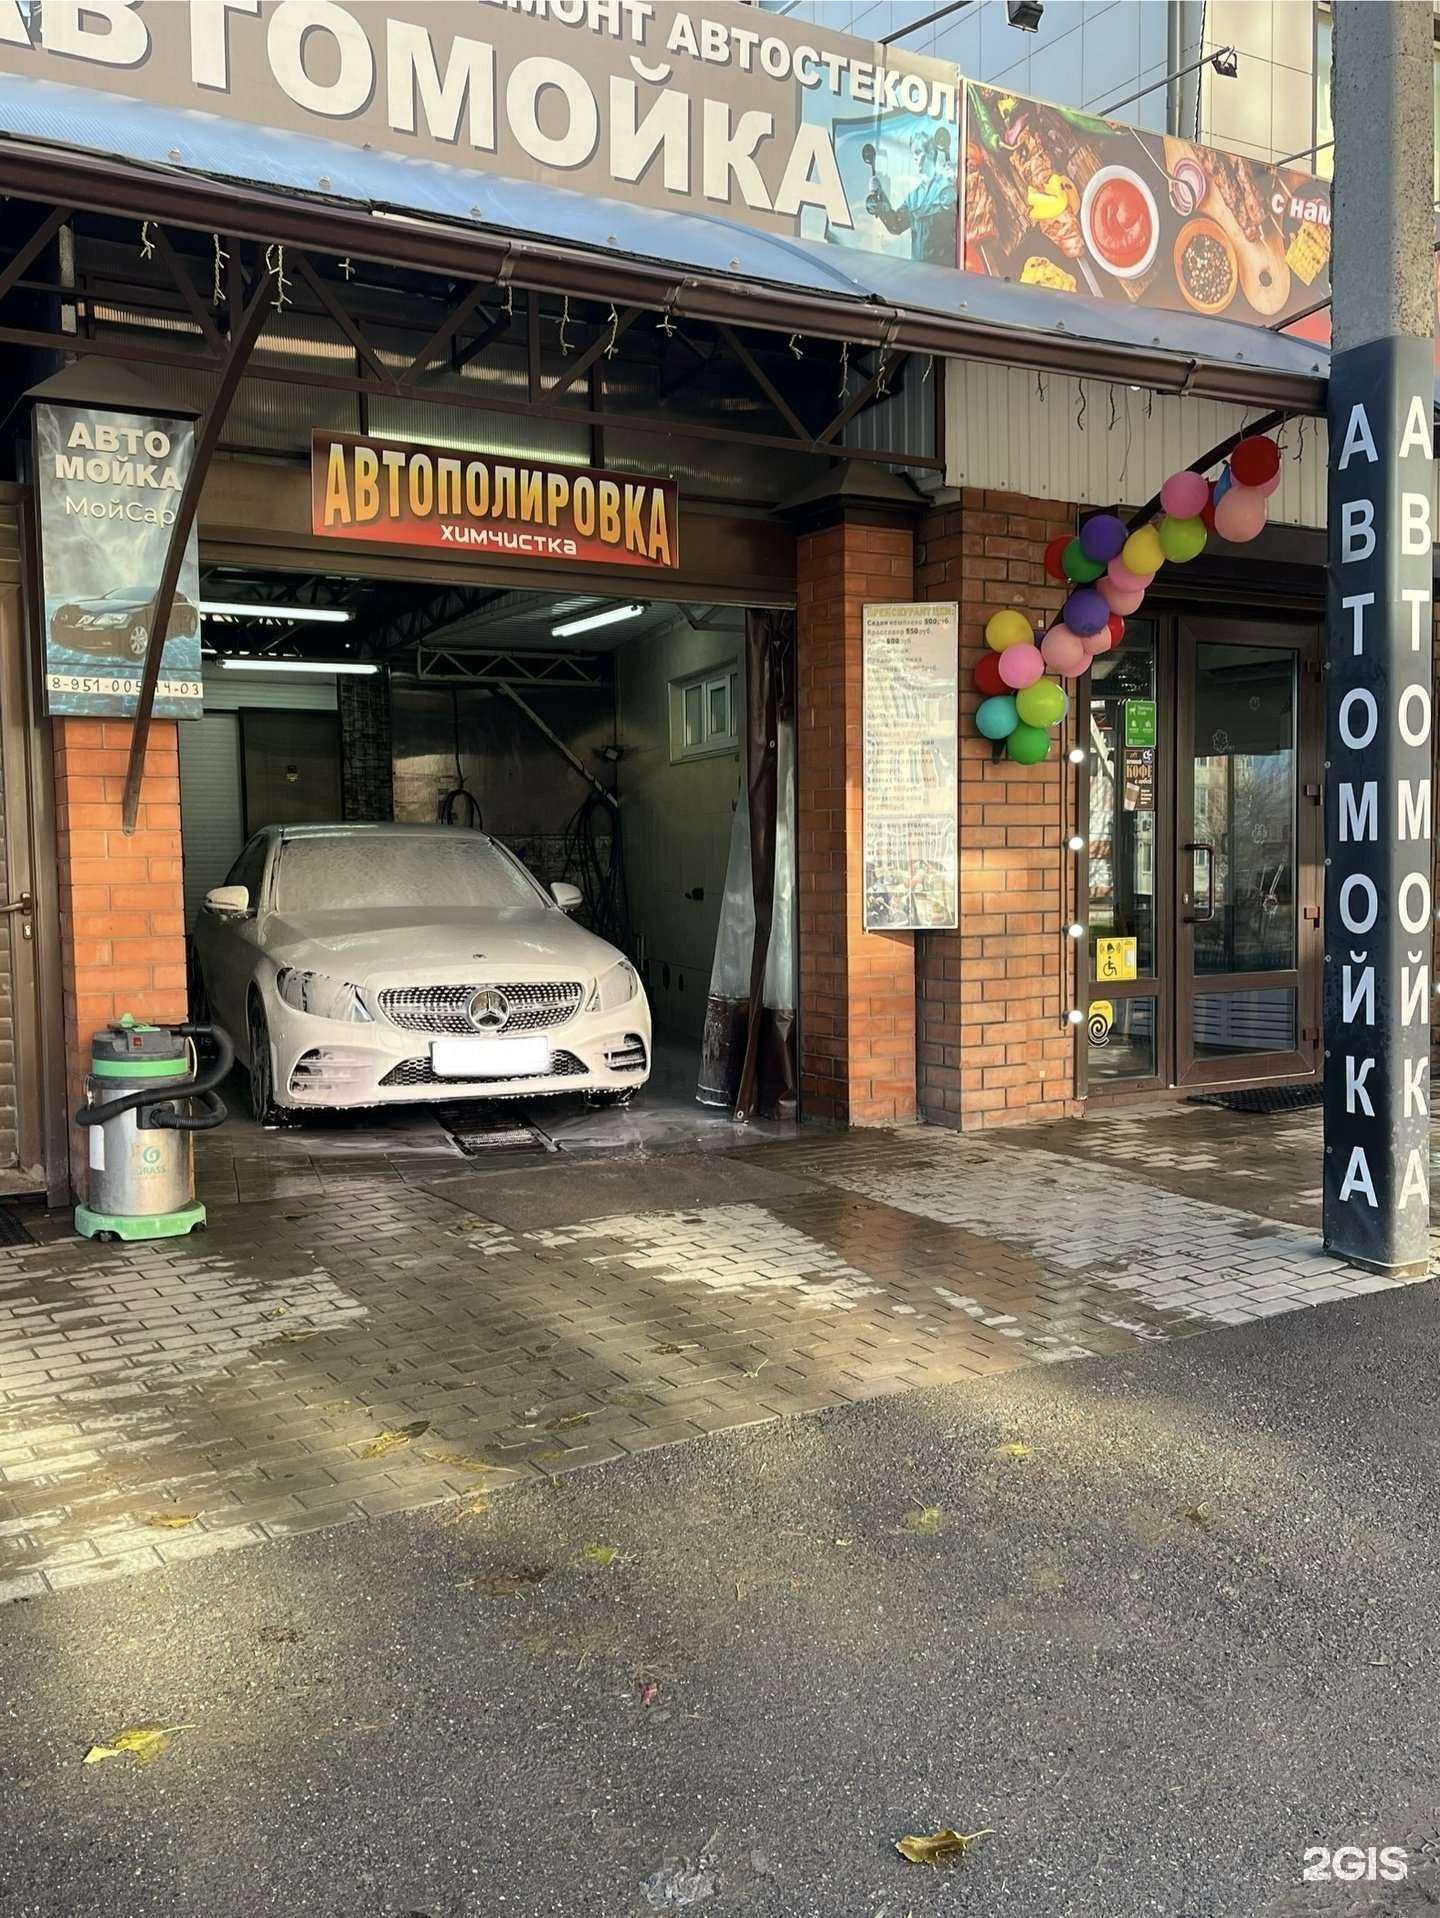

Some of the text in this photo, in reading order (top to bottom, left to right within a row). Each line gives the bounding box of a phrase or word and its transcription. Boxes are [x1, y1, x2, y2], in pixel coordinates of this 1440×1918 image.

[667, 11, 956, 123] АВТОСТЕКОЛ
[55, 454, 182, 491] МОЙКА
[66, 421, 171, 459] АВТО
[323, 442, 672, 566] АВТОПОЛИРОВКА
[440, 523, 577, 555] химчистка
[52, 676, 200, 697] 8-951-00514-03
[1338, 403, 1379, 1208] АВТОМОЙКА
[1398, 396, 1434, 1209] АВТОМОЙКА
